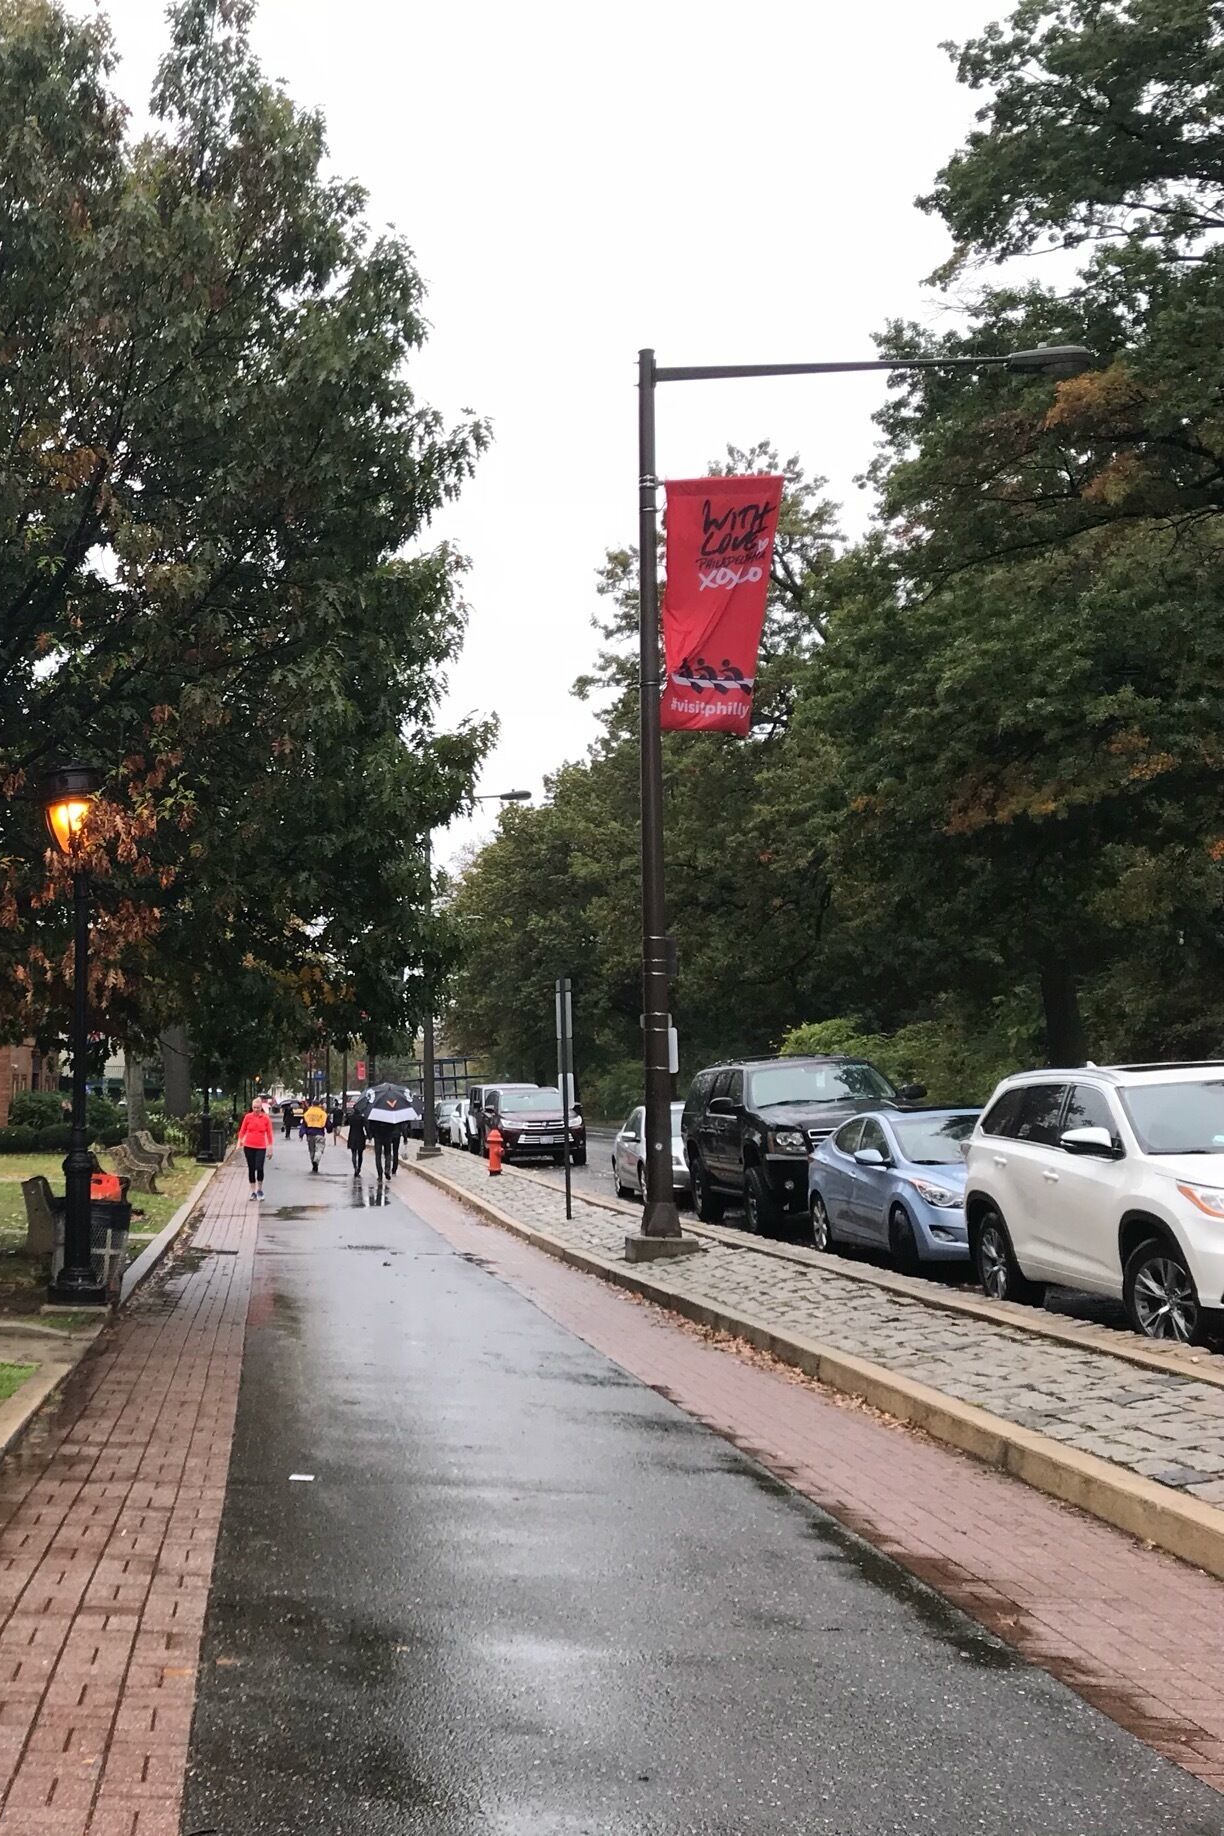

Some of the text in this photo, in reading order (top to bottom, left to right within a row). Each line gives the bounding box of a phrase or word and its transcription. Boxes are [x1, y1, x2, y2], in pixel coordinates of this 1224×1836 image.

[702, 499, 776, 534] WITH
[701, 530, 759, 556] LOVE
[670, 697, 750, 719] #visitphilly
